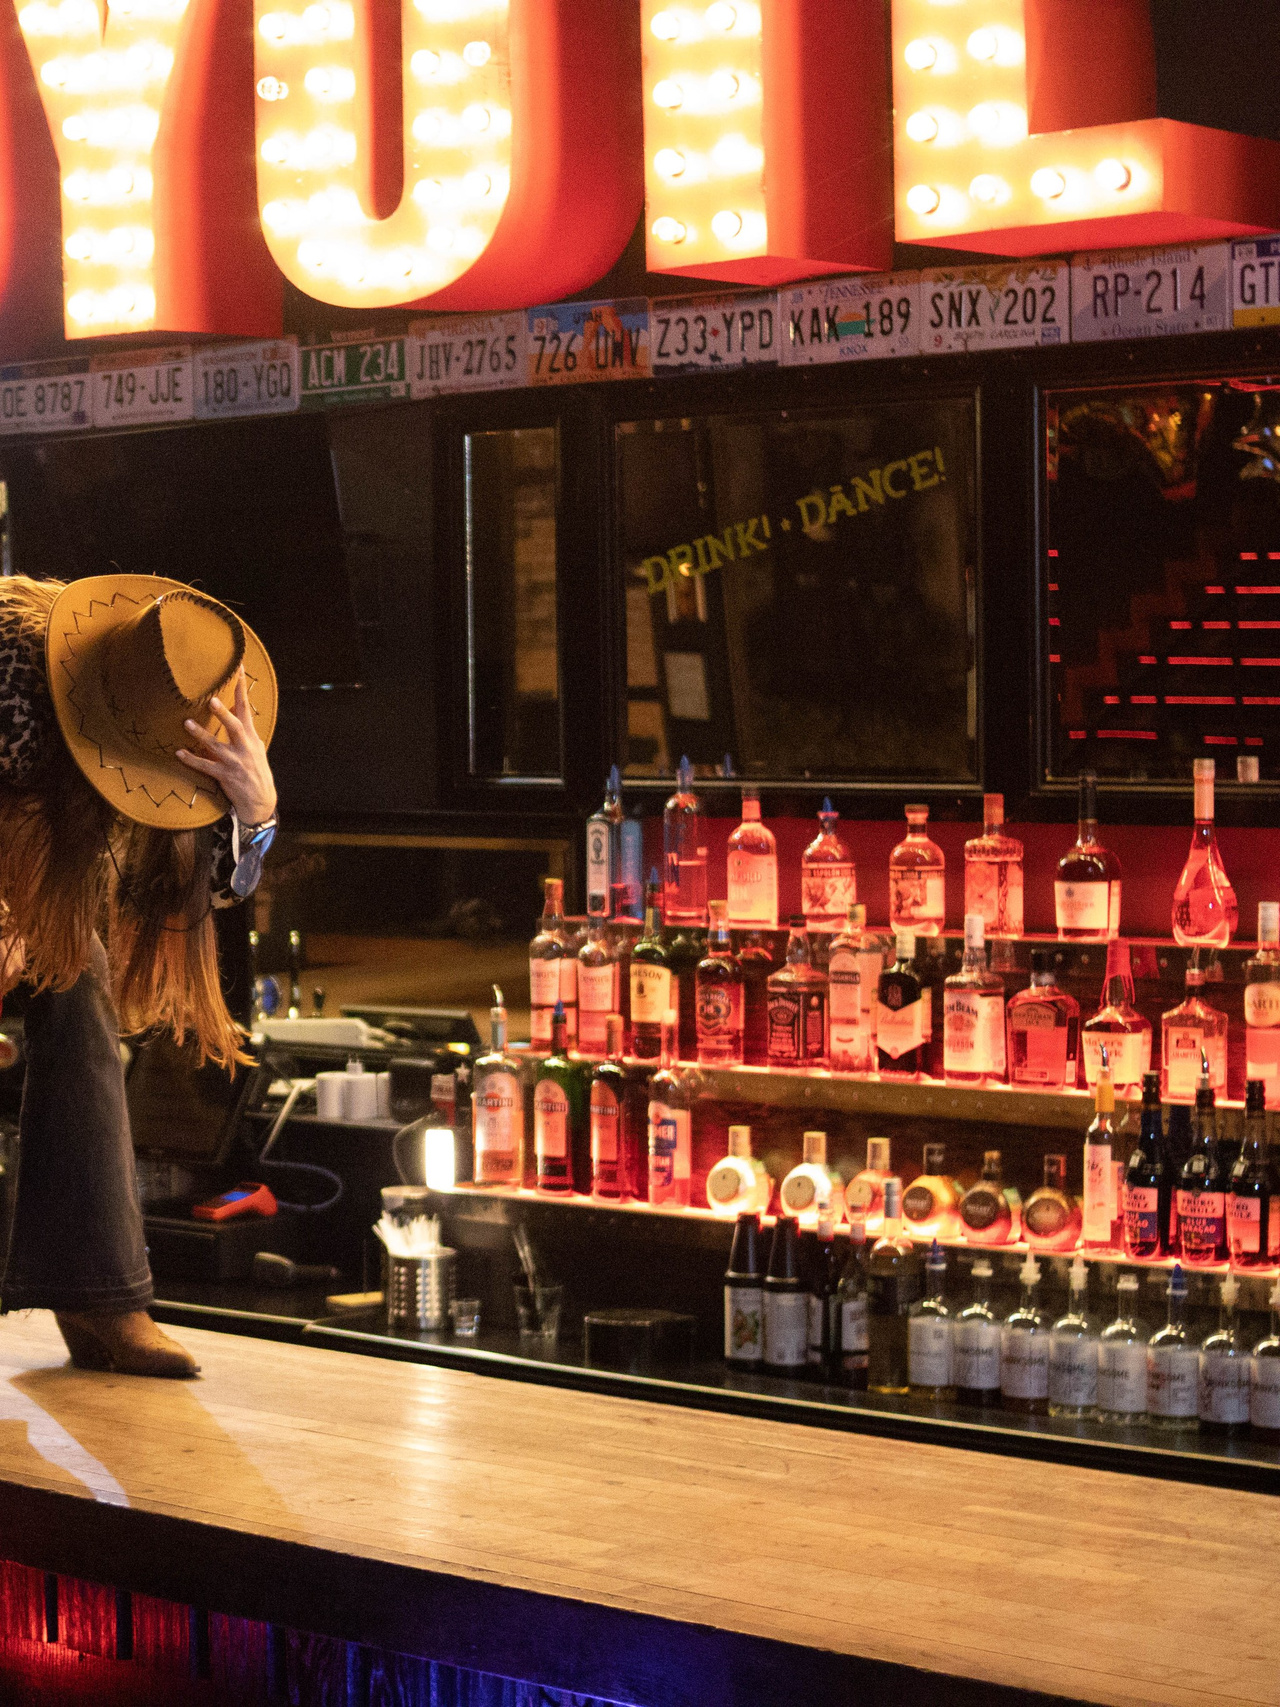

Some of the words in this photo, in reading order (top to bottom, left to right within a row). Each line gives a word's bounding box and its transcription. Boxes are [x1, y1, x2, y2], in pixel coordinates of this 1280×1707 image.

[1092, 264, 1207, 318] RP-214
[1240, 261, 1280, 305] GT
[789, 304, 840, 346] KAK
[863, 296, 911, 338] 189
[930, 289, 981, 329] SNX
[1003, 286, 1056, 325] 202
[308, 348, 347, 388] ACM
[359, 342, 399, 382] 234
[533, 332, 577, 374] 726
[34, 380, 87, 414] 8787
[642, 513, 772, 595] DRINK!
